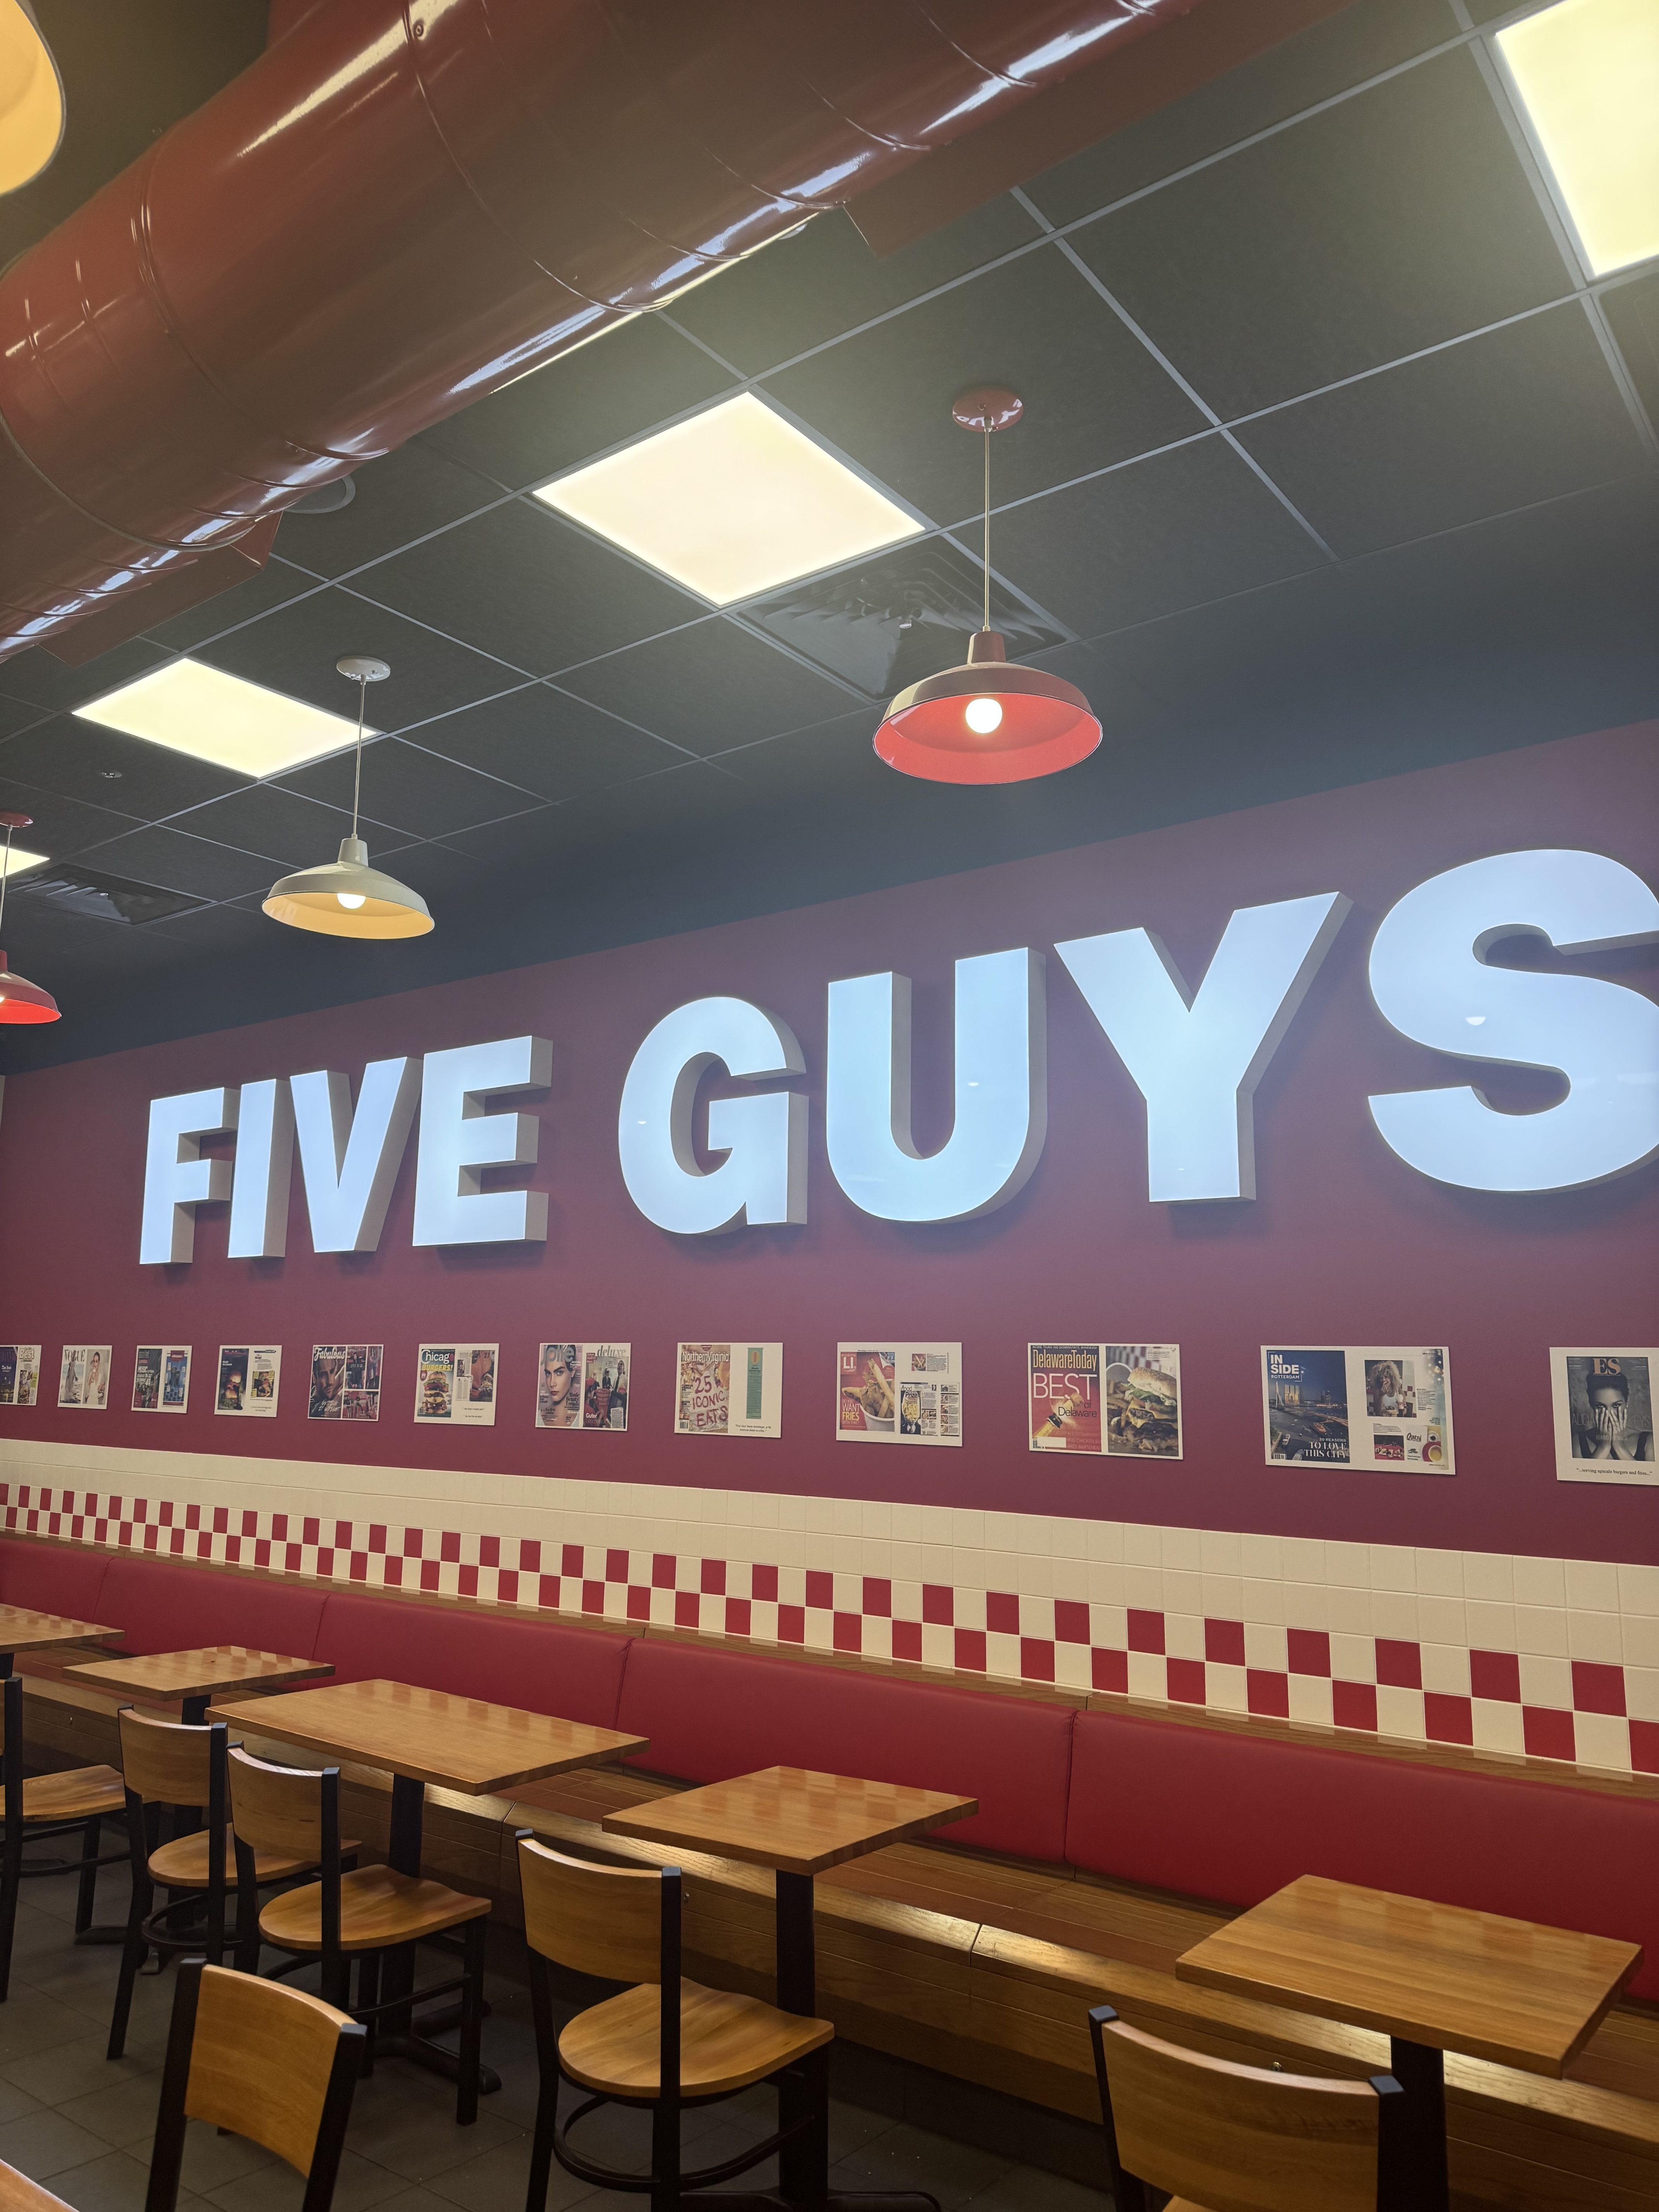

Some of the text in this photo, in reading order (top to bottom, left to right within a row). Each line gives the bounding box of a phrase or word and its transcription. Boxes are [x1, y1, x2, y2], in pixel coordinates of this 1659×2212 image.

[140, 849, 1659, 1264] FIVE GUYS
[19, 1348, 34, 1359] Best
[314, 1346, 345, 1361] Fabulous
[597, 1345, 626, 1357] deluxe
[843, 1357, 854, 1369] LI
[1271, 1355, 1283, 1364] IN
[1271, 1364, 1299, 1374] SIDE
[1593, 1358, 1621, 1375] ES
[695, 1376, 712, 1394] 25
[1033, 1373, 1097, 1400] BEST
[692, 1391, 725, 1410] ICONIC
[842, 1403, 859, 1412] WANT
[1058, 1407, 1097, 1417] Delaware
[697, 1405, 728, 1427] EATS
[842, 1412, 859, 1420] FRIES
